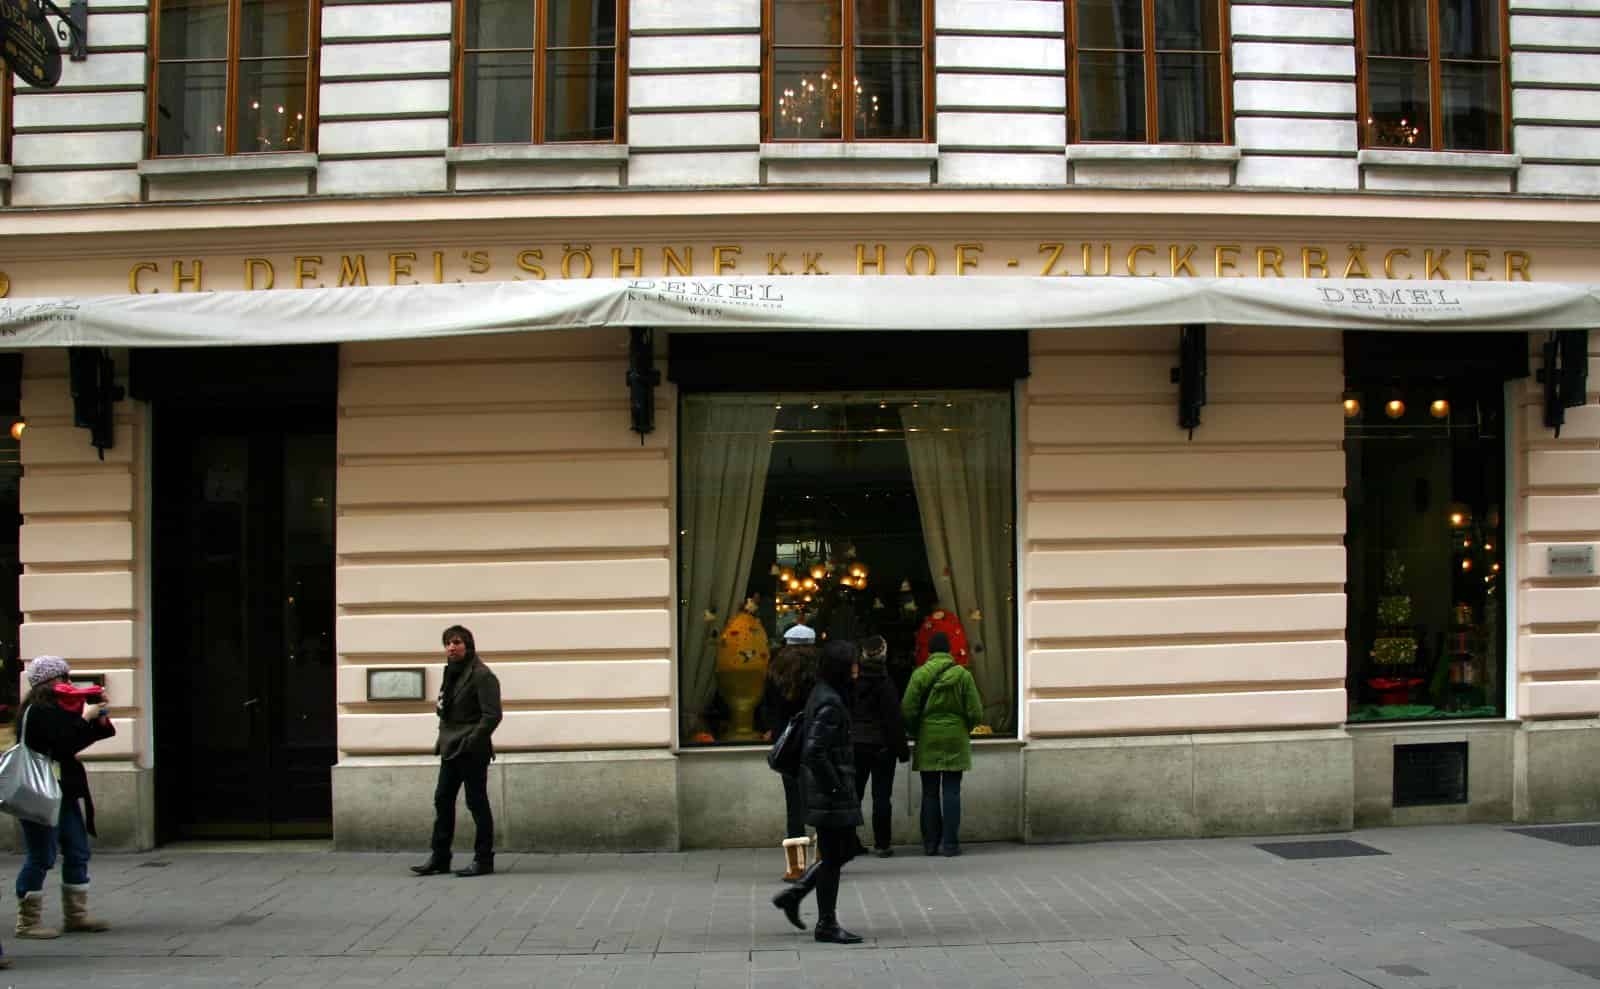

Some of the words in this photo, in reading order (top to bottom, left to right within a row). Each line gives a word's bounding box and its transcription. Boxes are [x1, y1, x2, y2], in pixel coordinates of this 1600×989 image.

[512, 243, 743, 281] SÖHNE
[628, 279, 784, 302] DEMEL
[1317, 287, 1461, 305] DEMEL
